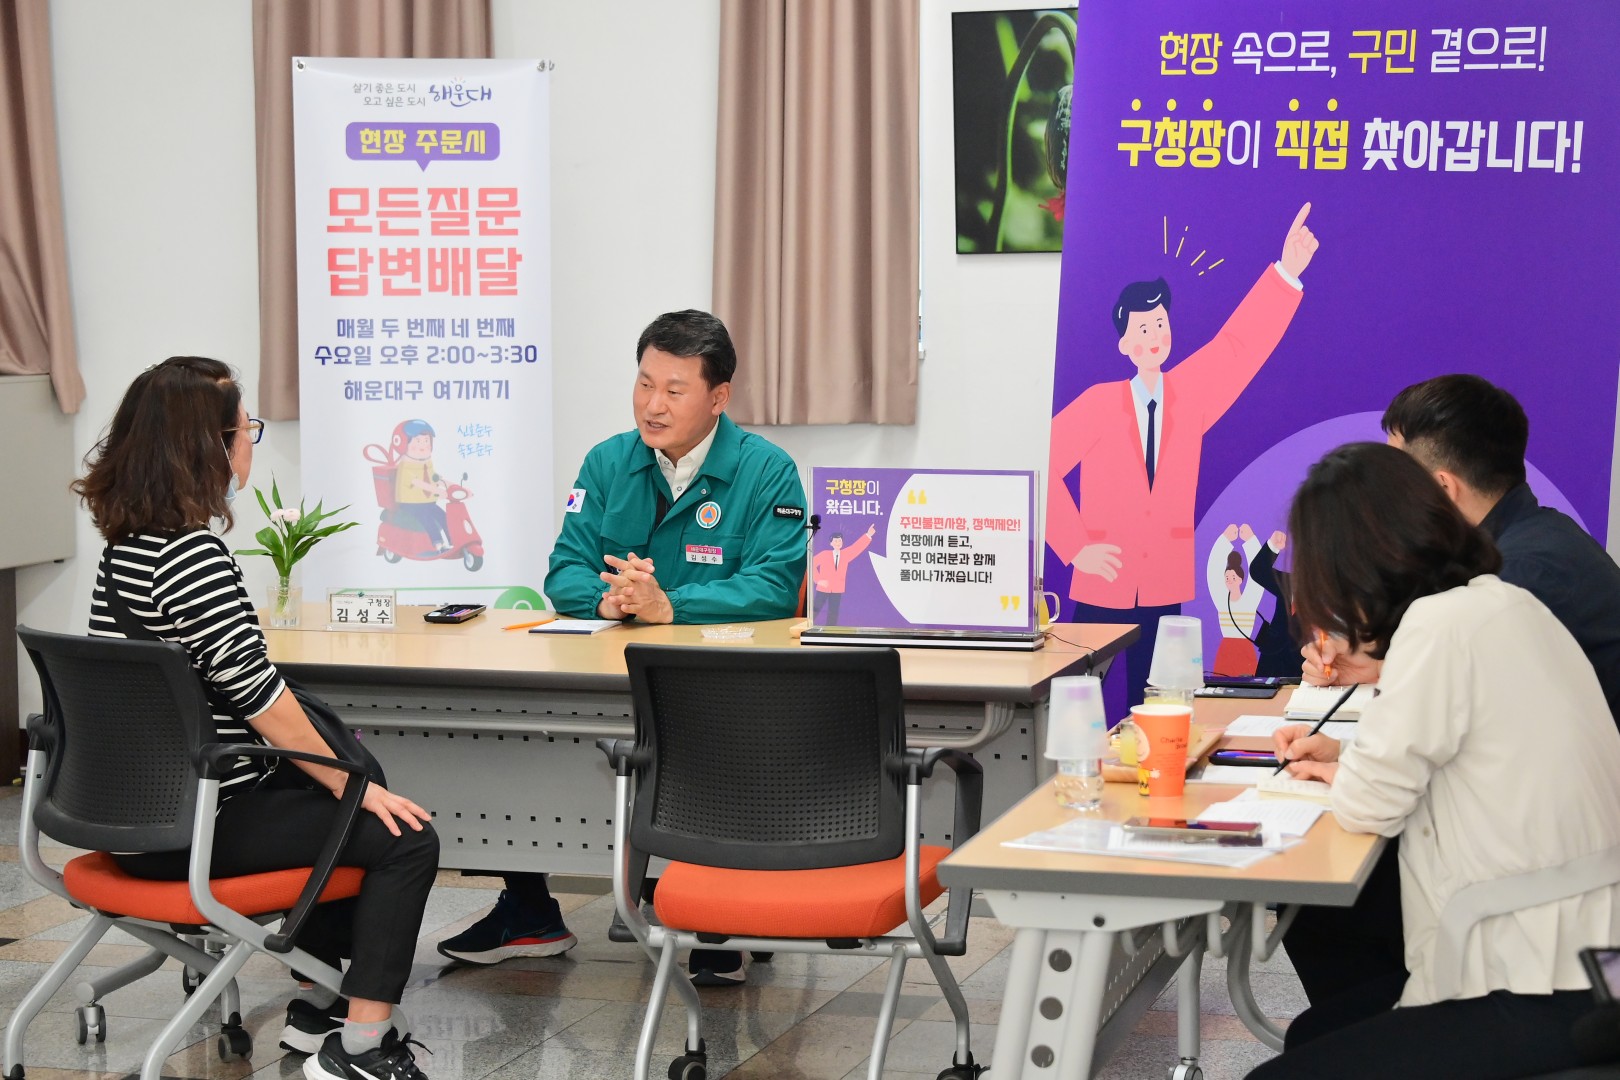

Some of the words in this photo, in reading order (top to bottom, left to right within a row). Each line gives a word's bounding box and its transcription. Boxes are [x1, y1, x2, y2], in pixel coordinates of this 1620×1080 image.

[1160, 31, 1224, 76] 현장
[1231, 31, 1338, 79] 속으로,
[1348, 29, 1418, 75] 구민
[1430, 26, 1548, 73] 곁으로!
[353, 83, 372, 94] 살기
[375, 83, 394, 94] 좋은
[397, 83, 416, 94] 도시
[428, 84, 493, 108] 해운대
[363, 96, 382, 107] 오고
[385, 96, 404, 108] 싶은
[407, 96, 426, 107] 도시
[359, 127, 407, 154] 현장
[415, 129, 487, 155] 주문시
[1117, 117, 1261, 169] 구청장이
[1275, 119, 1350, 170] 직접
[1362, 117, 1585, 174] 찾아갑니다!
[326, 187, 521, 236] 모든질문
[327, 247, 523, 297] 답변배달
[336, 318, 375, 339] 매월
[380, 318, 400, 339] 두
[407, 318, 446, 338] 번째
[451, 318, 470, 338] 네
[476, 317, 515, 338] 번째
[314, 345, 372, 366] 수요일
[380, 344, 419, 366] 오후
[426, 344, 538, 365] 2:00~3:30
[343, 379, 424, 401] 해운대구
[433, 379, 510, 400] 여기저기
[825, 479, 880, 496] 구청장이
[825, 500, 884, 516] 왔습니다.
[900, 516, 970, 532] 주민불편사항,
[972, 517, 1021, 532] 정책제안!
[900, 533, 944, 548] 현장에서
[947, 535, 973, 550] 듣고,
[900, 551, 922, 565] 주민
[925, 552, 970, 566] 여러분과
[972, 552, 996, 567] 함께
[900, 569, 993, 584] 풀어나가겠습니다!
[367, 598, 391, 608] 구청장
